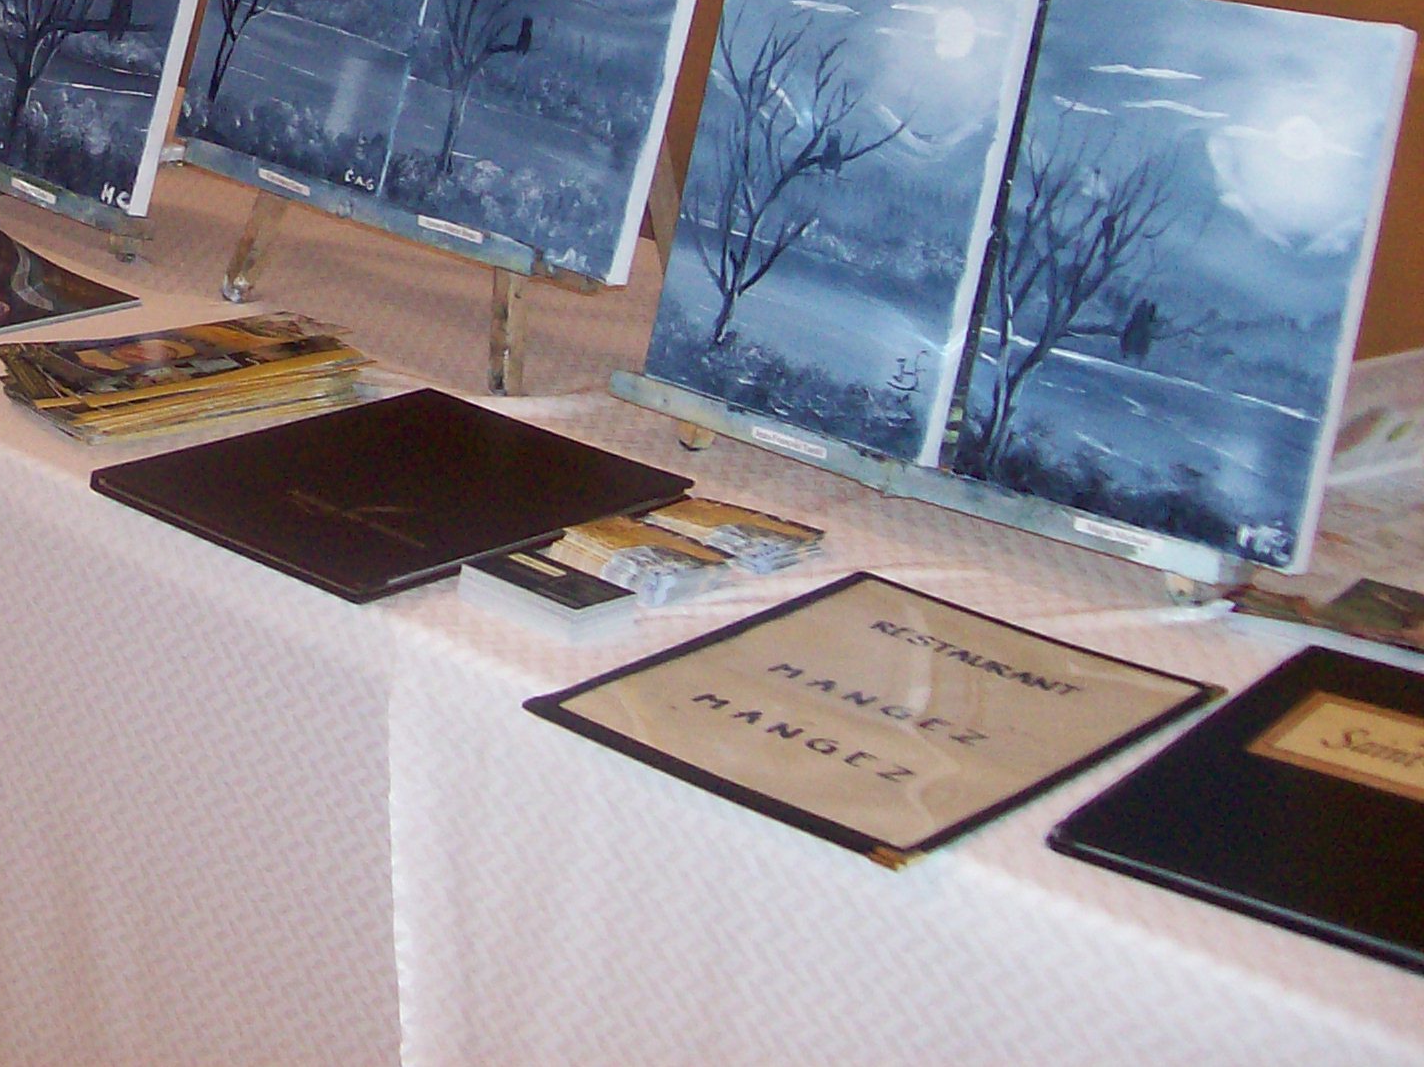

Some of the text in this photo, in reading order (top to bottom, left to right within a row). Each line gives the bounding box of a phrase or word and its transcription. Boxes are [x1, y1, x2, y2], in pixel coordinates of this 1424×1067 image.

[870, 618, 1083, 697] RESTAURANT
[692, 693, 918, 785] MANGEZ
[766, 663, 990, 749] MANGEZ
